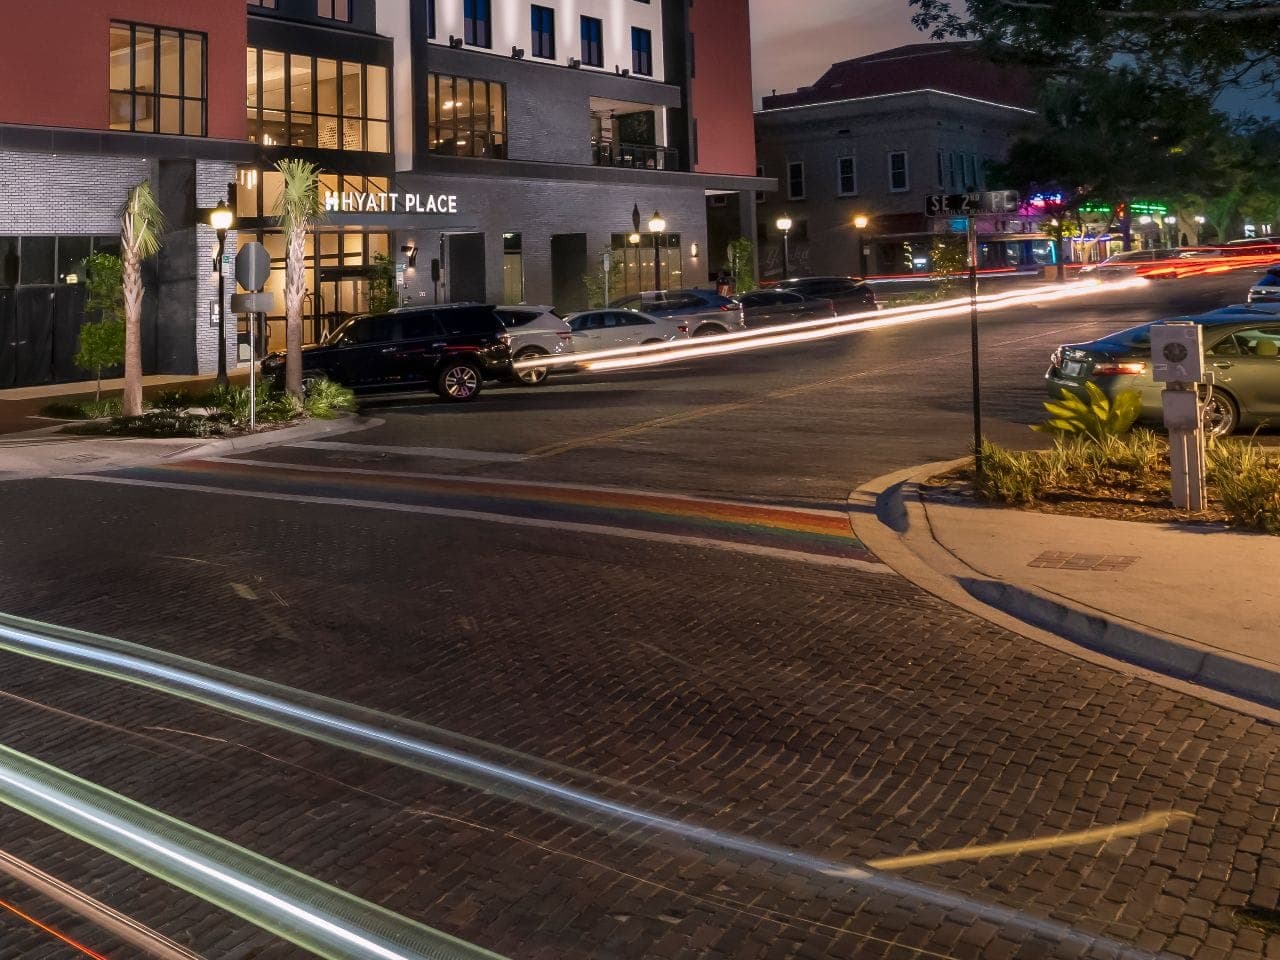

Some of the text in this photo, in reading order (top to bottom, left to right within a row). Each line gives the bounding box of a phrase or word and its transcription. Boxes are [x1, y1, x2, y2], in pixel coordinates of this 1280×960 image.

[341, 192, 458, 213] HYATT PLACE
[931, 195, 950, 211] SE
[991, 192, 1014, 209] PL
